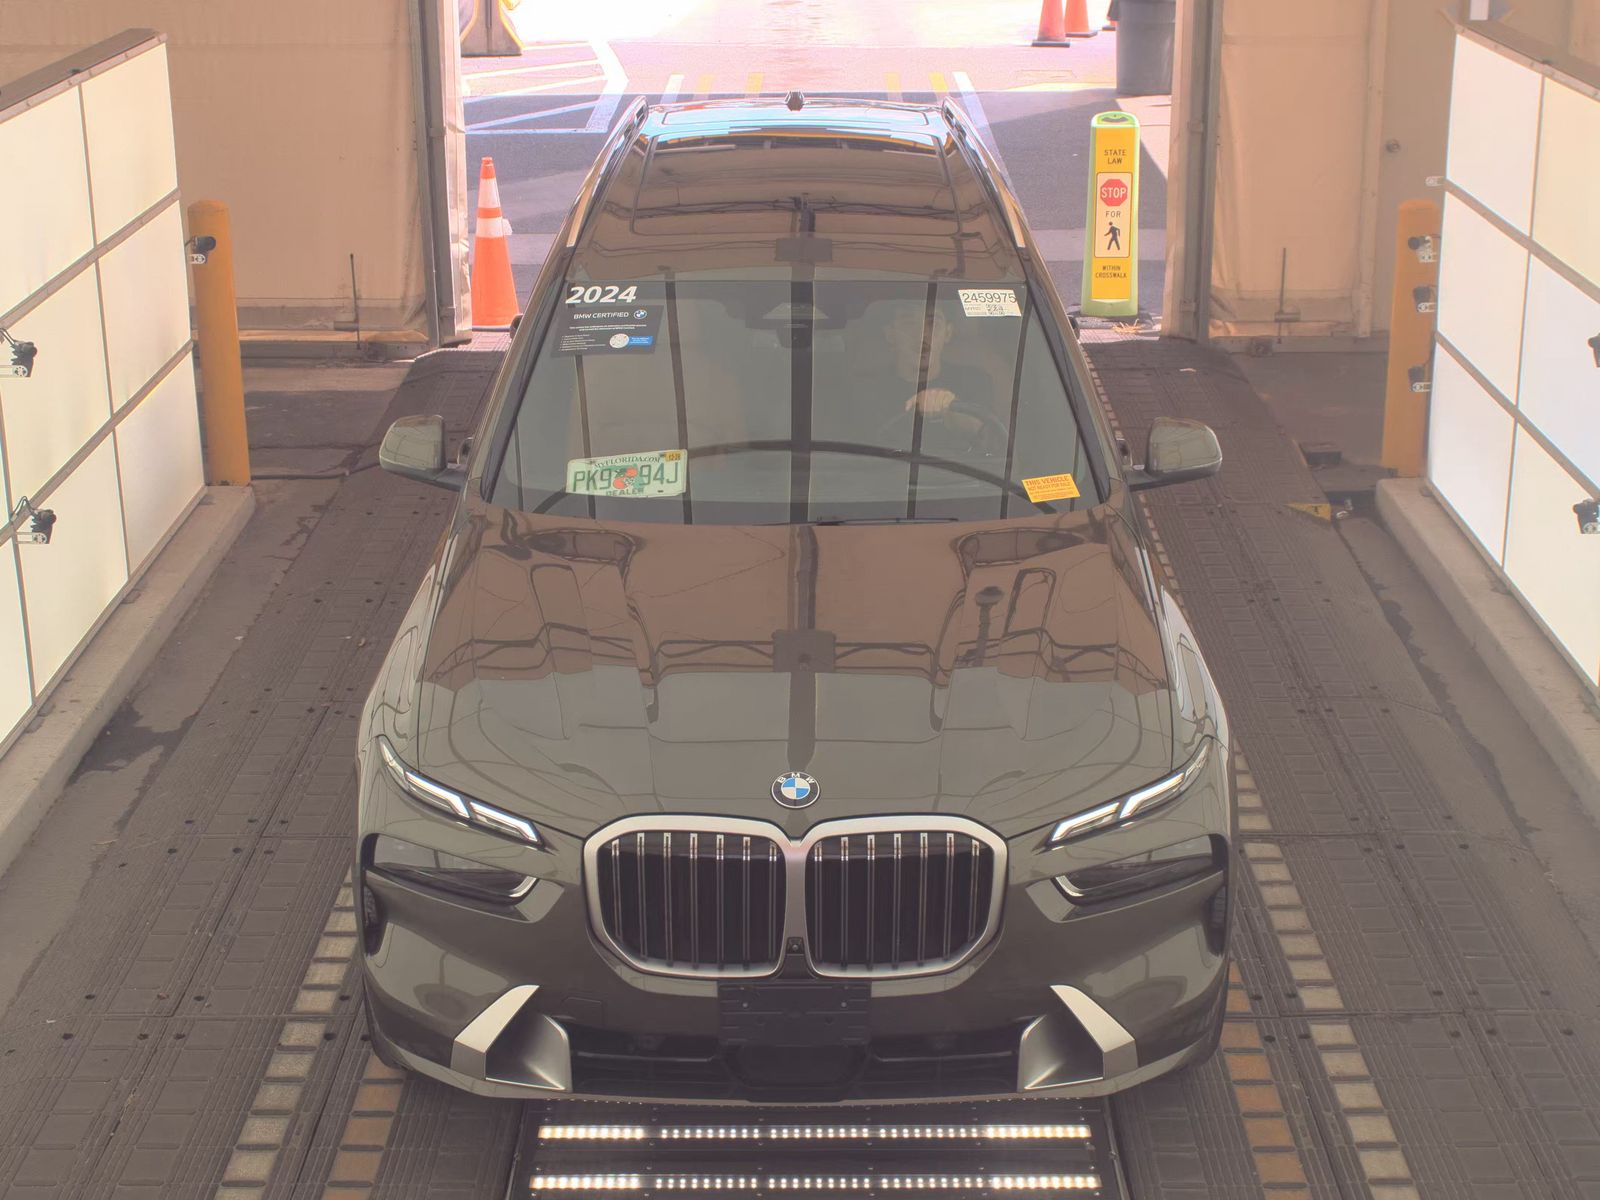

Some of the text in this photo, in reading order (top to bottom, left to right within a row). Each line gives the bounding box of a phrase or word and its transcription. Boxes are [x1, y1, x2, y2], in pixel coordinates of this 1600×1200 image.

[1101, 187, 1127, 199] STOP
[1105, 210, 1121, 218] FOR
[565, 285, 638, 304] 2024
[962, 292, 1017, 303] 2459975
[592, 311, 629, 319] CERTIFIED
[605, 488, 645, 497] DEALER
[777, 772, 815, 783] BMW
